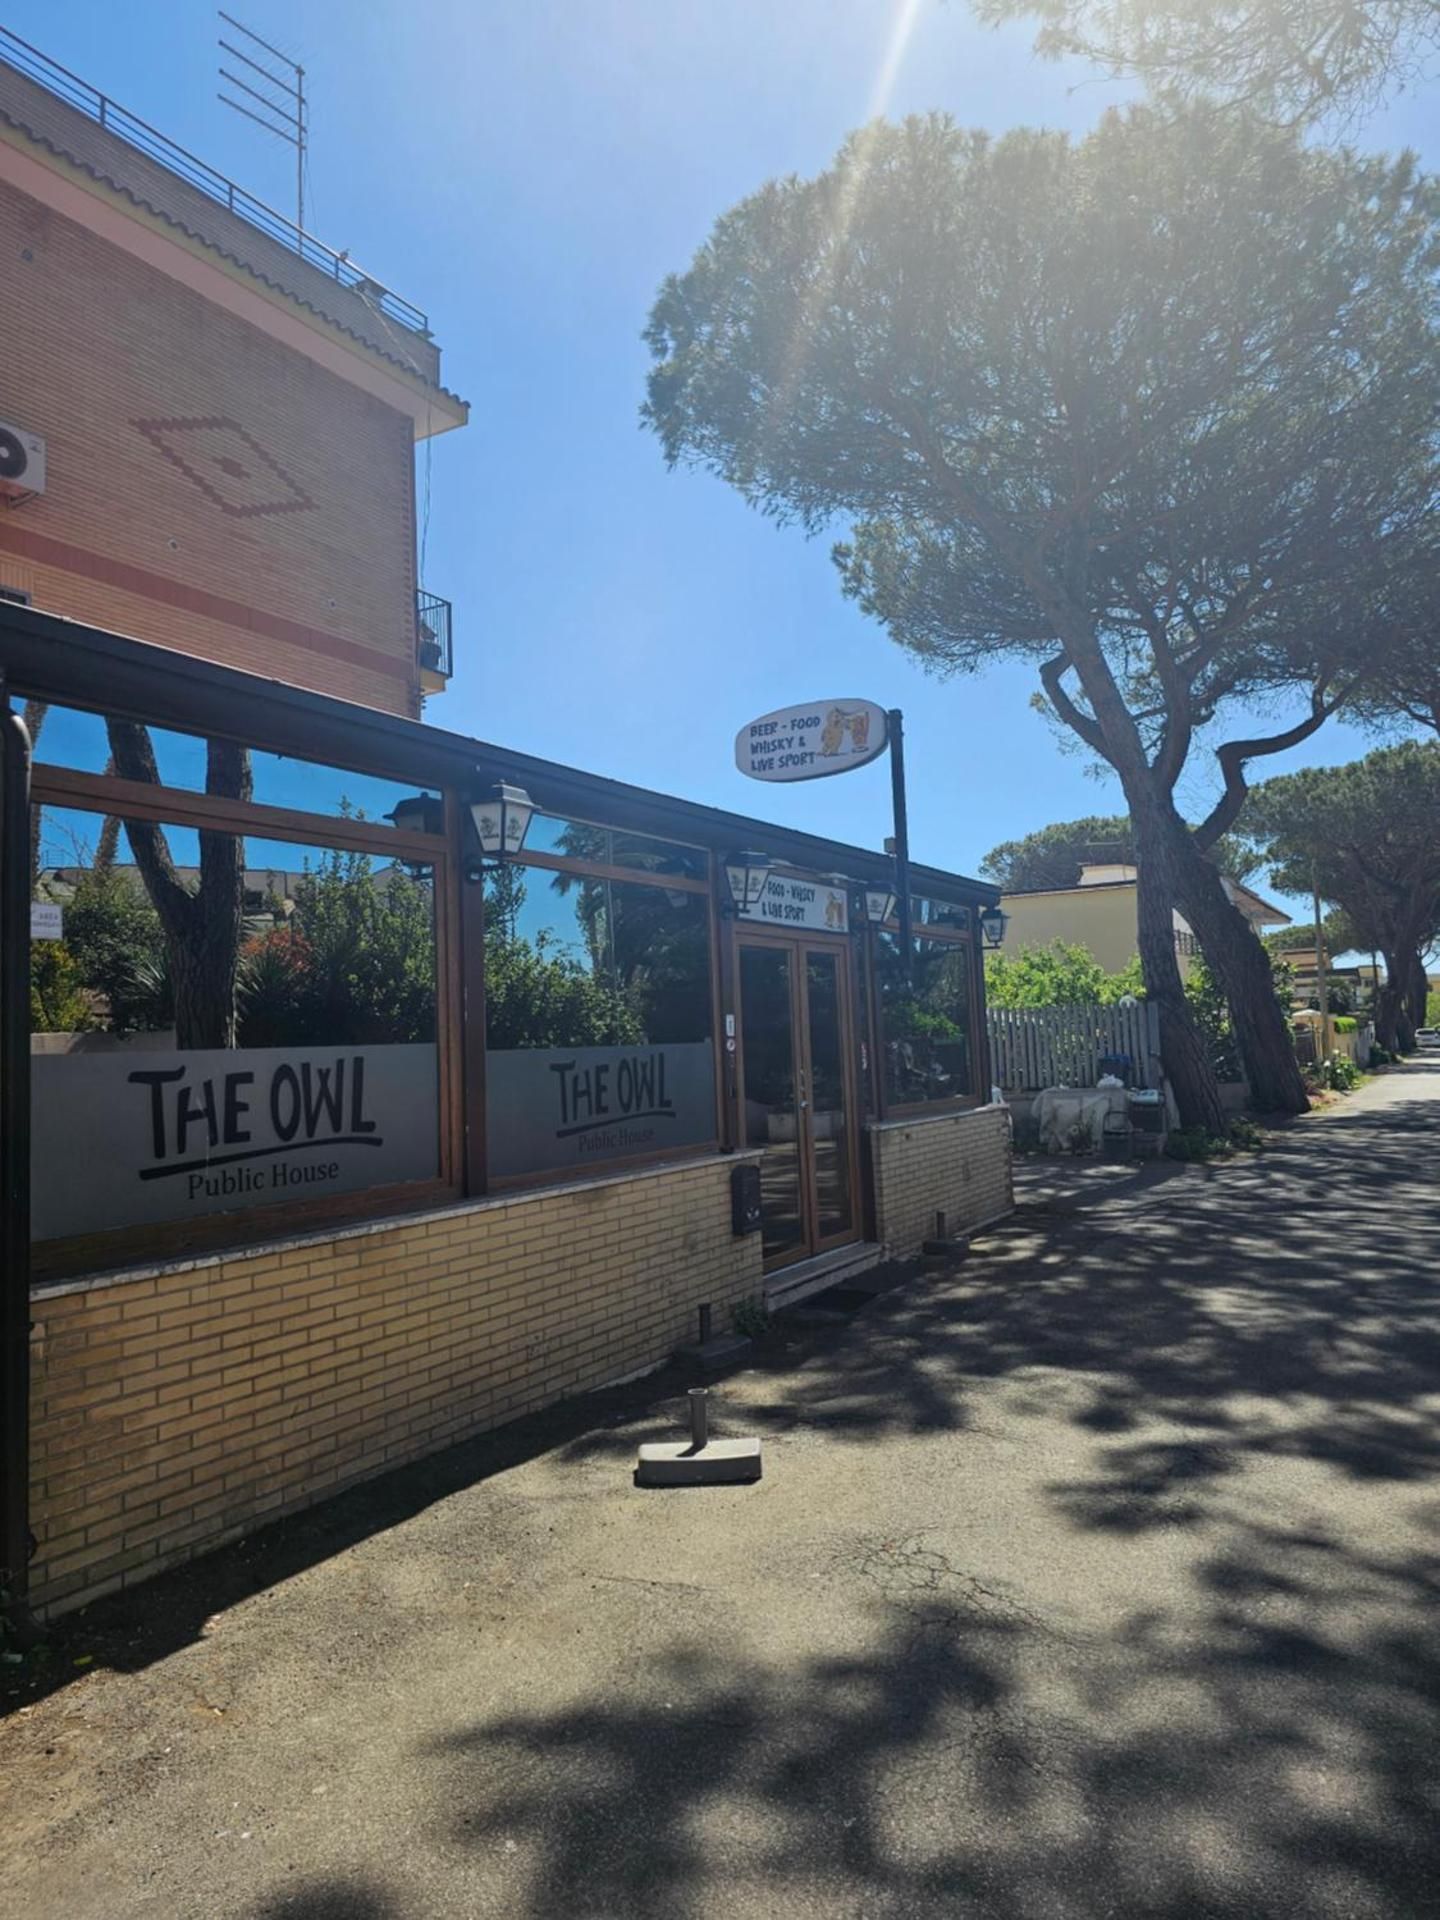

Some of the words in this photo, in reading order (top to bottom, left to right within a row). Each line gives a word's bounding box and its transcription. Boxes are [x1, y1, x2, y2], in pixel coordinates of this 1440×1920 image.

[750, 721, 778, 737] BEER
[790, 716, 820, 731] FOOD
[750, 737, 794, 754] WHISKY
[798, 736, 806, 747] &
[751, 756, 775, 772] LIVE
[778, 752, 816, 768] SPORT
[767, 881, 785, 897] FOOD
[790, 885, 816, 903] WHISKY
[768, 901, 782, 918] LIVE
[784, 904, 805, 922] SPORT
[549, 1059, 610, 1124] THE
[617, 1052, 673, 1114] OWL
[128, 1065, 255, 1160] THE
[269, 1056, 376, 1143] OWL
[578, 1131, 617, 1153] Public
[187, 1171, 265, 1200] Public
[271, 1161, 340, 1188] House
